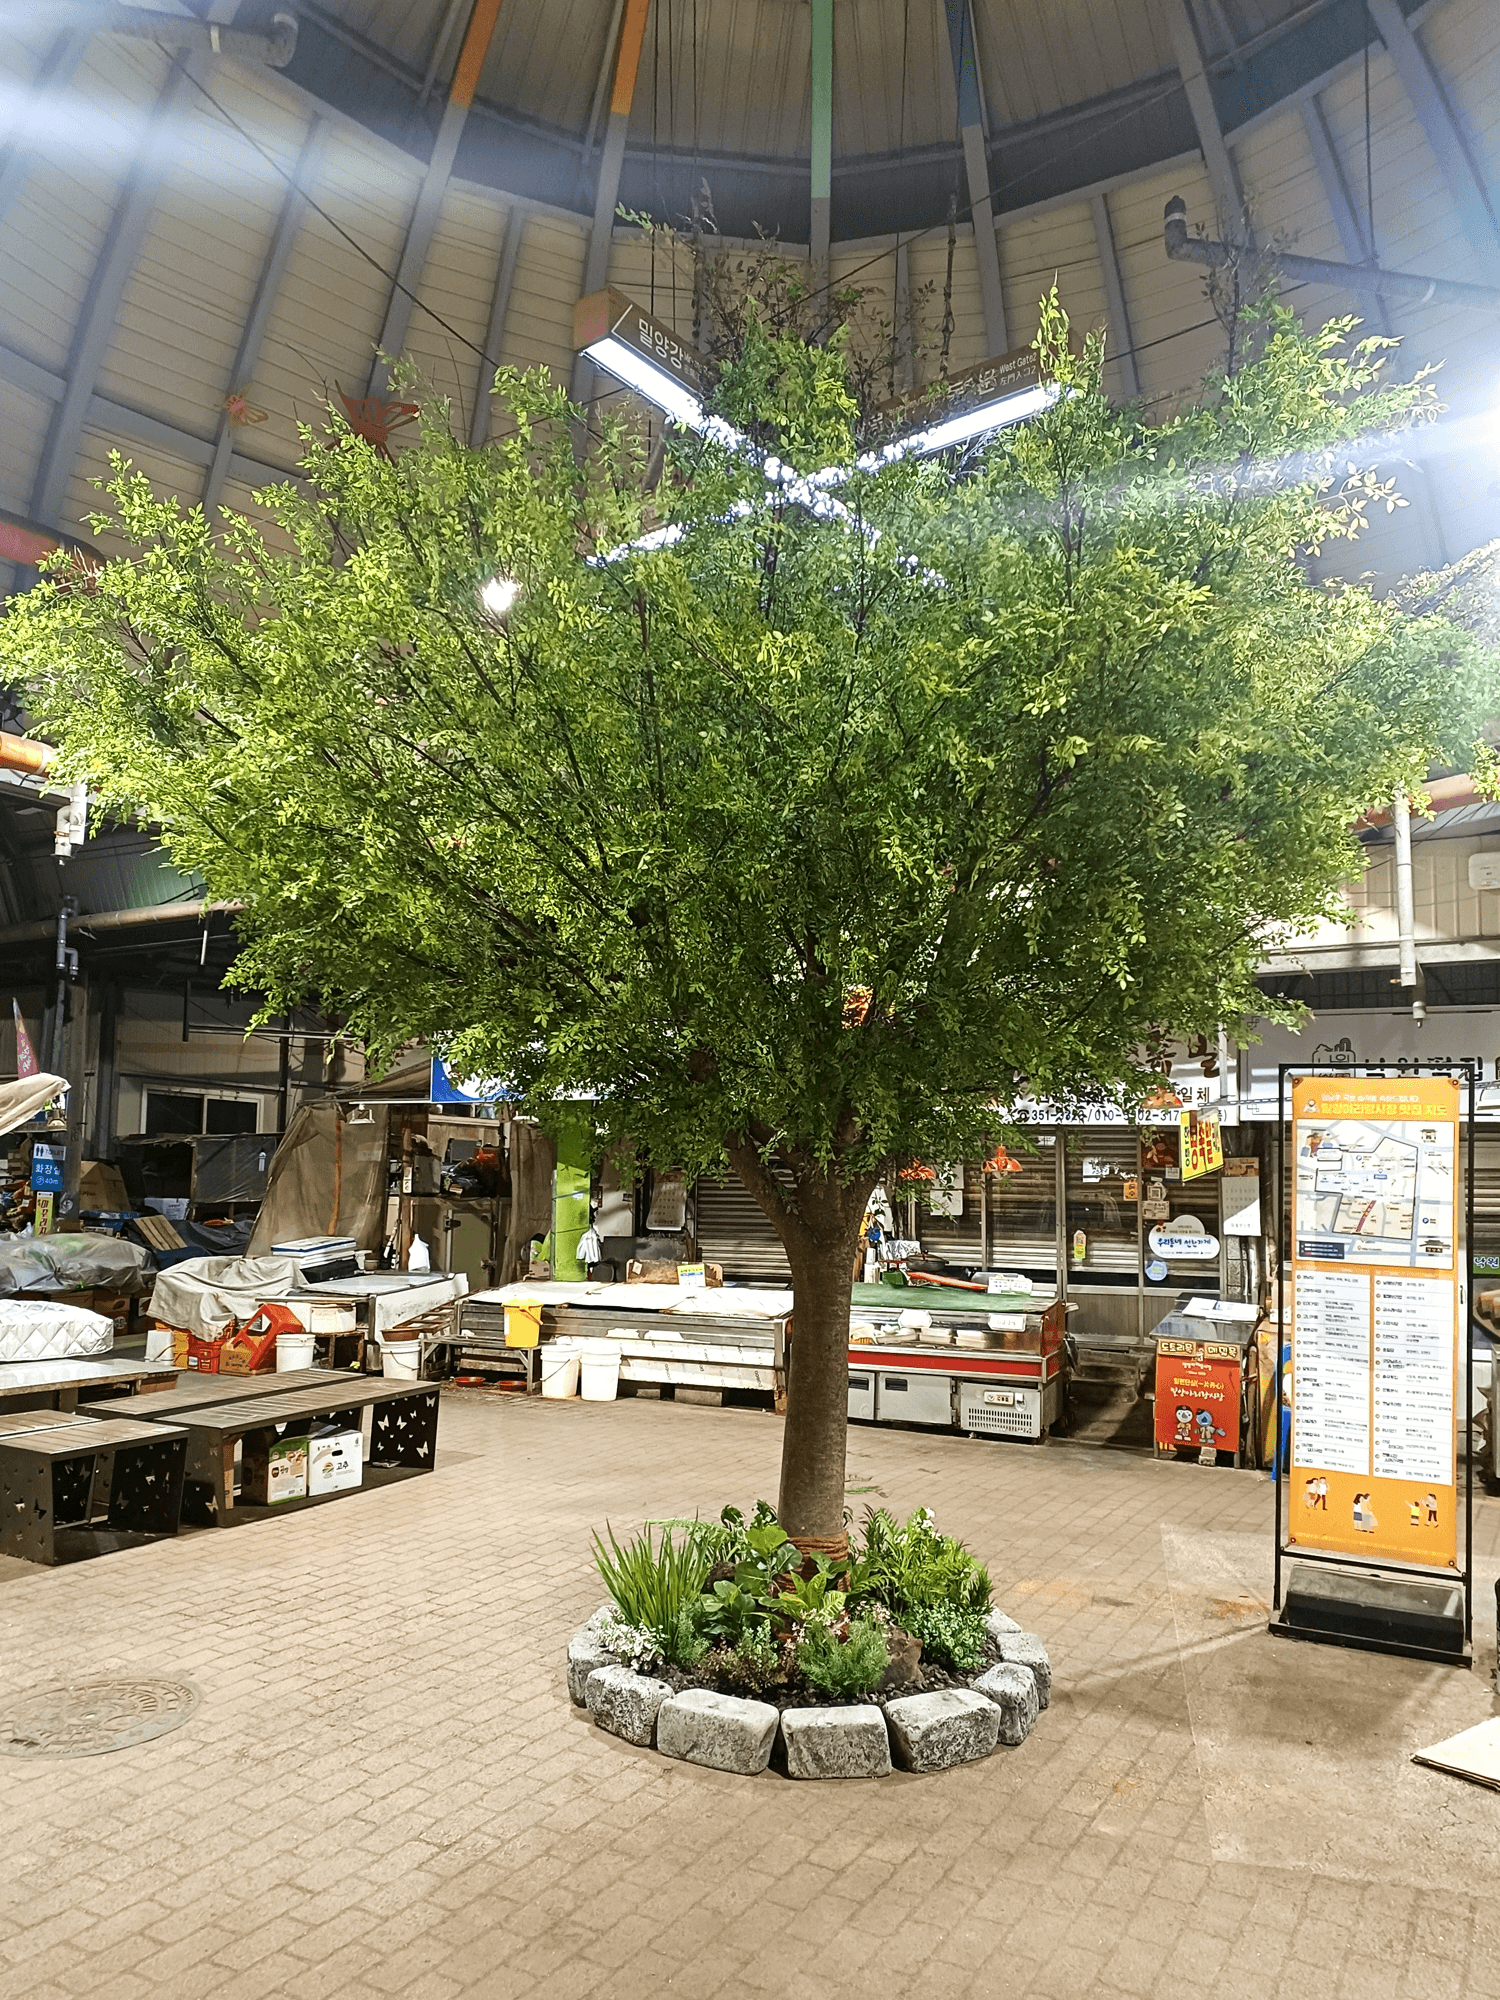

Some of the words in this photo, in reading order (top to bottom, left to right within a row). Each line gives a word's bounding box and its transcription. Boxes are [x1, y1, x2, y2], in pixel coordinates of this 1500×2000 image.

[638, 318, 683, 370] 밀양강
[999, 360, 1016, 374] West
[1017, 352, 1037, 367] Gate2
[1321, 1103, 1397, 1115] 밀양아리랑시장
[1425, 1104, 1447, 1116] 지도
[35, 1163, 61, 1176] 화장실
[1157, 1238, 1182, 1248] 우리동네
[1474, 1256, 1499, 1268] 낙원
[1161, 1342, 1193, 1354] 도토리묵
[1208, 1346, 1238, 1357] 메밀묵
[1170, 1387, 1225, 1402] 밀양아리랑시장
[336, 1460, 349, 1470] 고추
